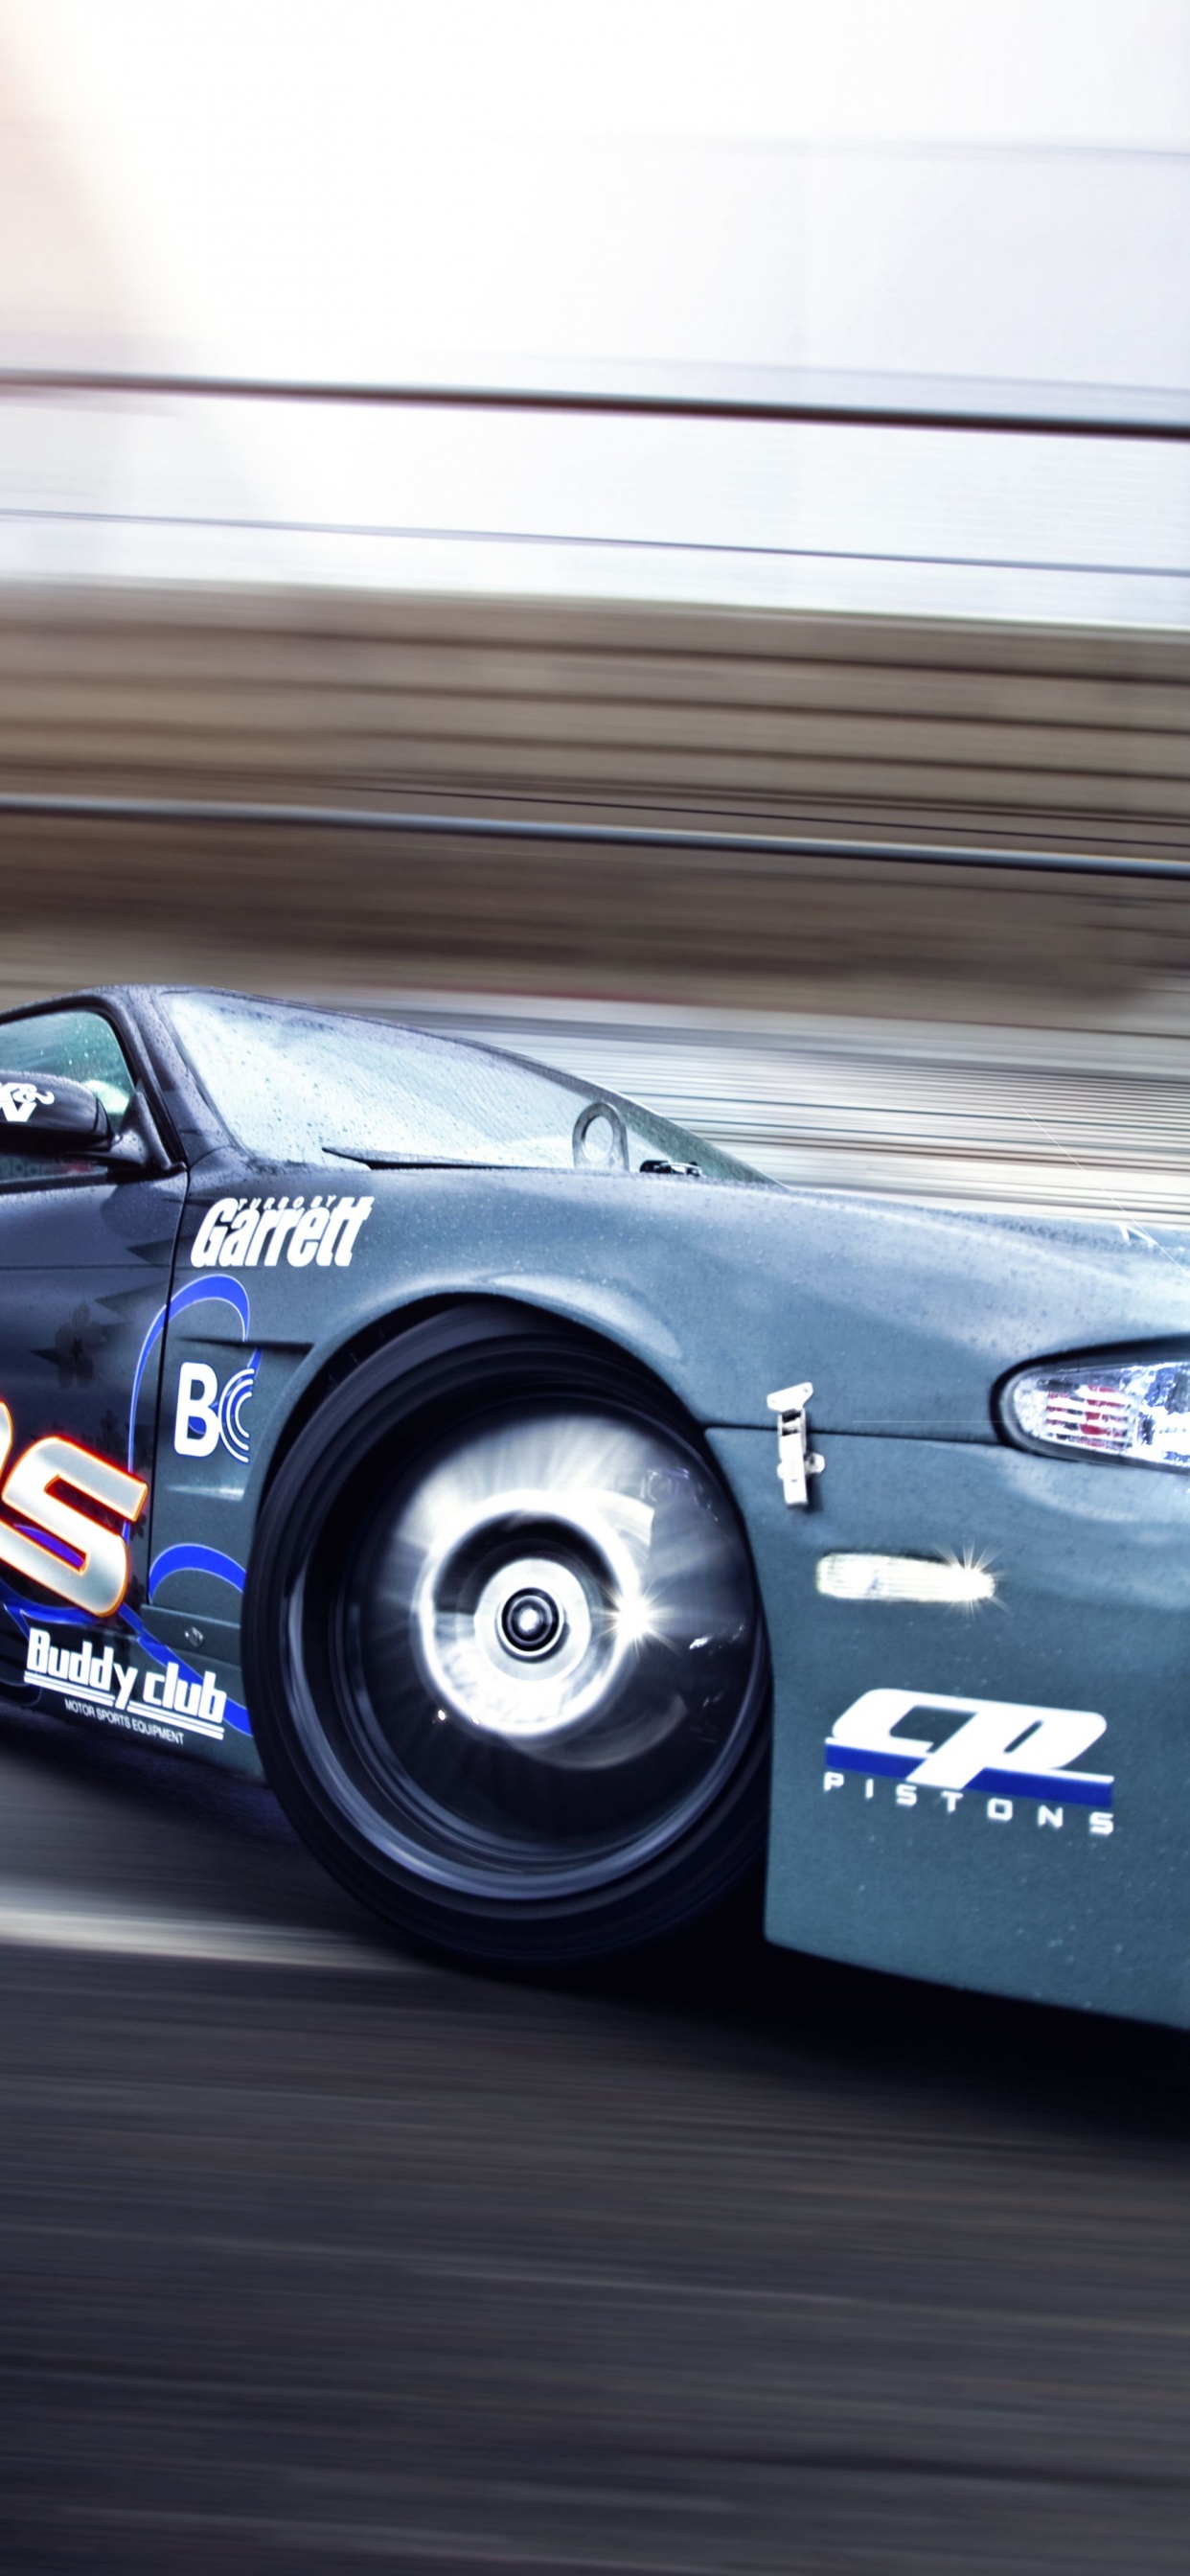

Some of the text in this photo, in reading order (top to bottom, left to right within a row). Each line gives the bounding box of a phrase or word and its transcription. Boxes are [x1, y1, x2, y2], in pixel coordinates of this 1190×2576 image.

[191, 1196, 375, 1268] Garrett
[238, 1195, 336, 1210] TURBO BY
[174, 1362, 255, 1463] BC
[27, 1627, 227, 1724] Buddy club
[64, 1697, 184, 1745] MOTOR SPORTS EQUIPMENT
[824, 1772, 1114, 1835] PISTONS
